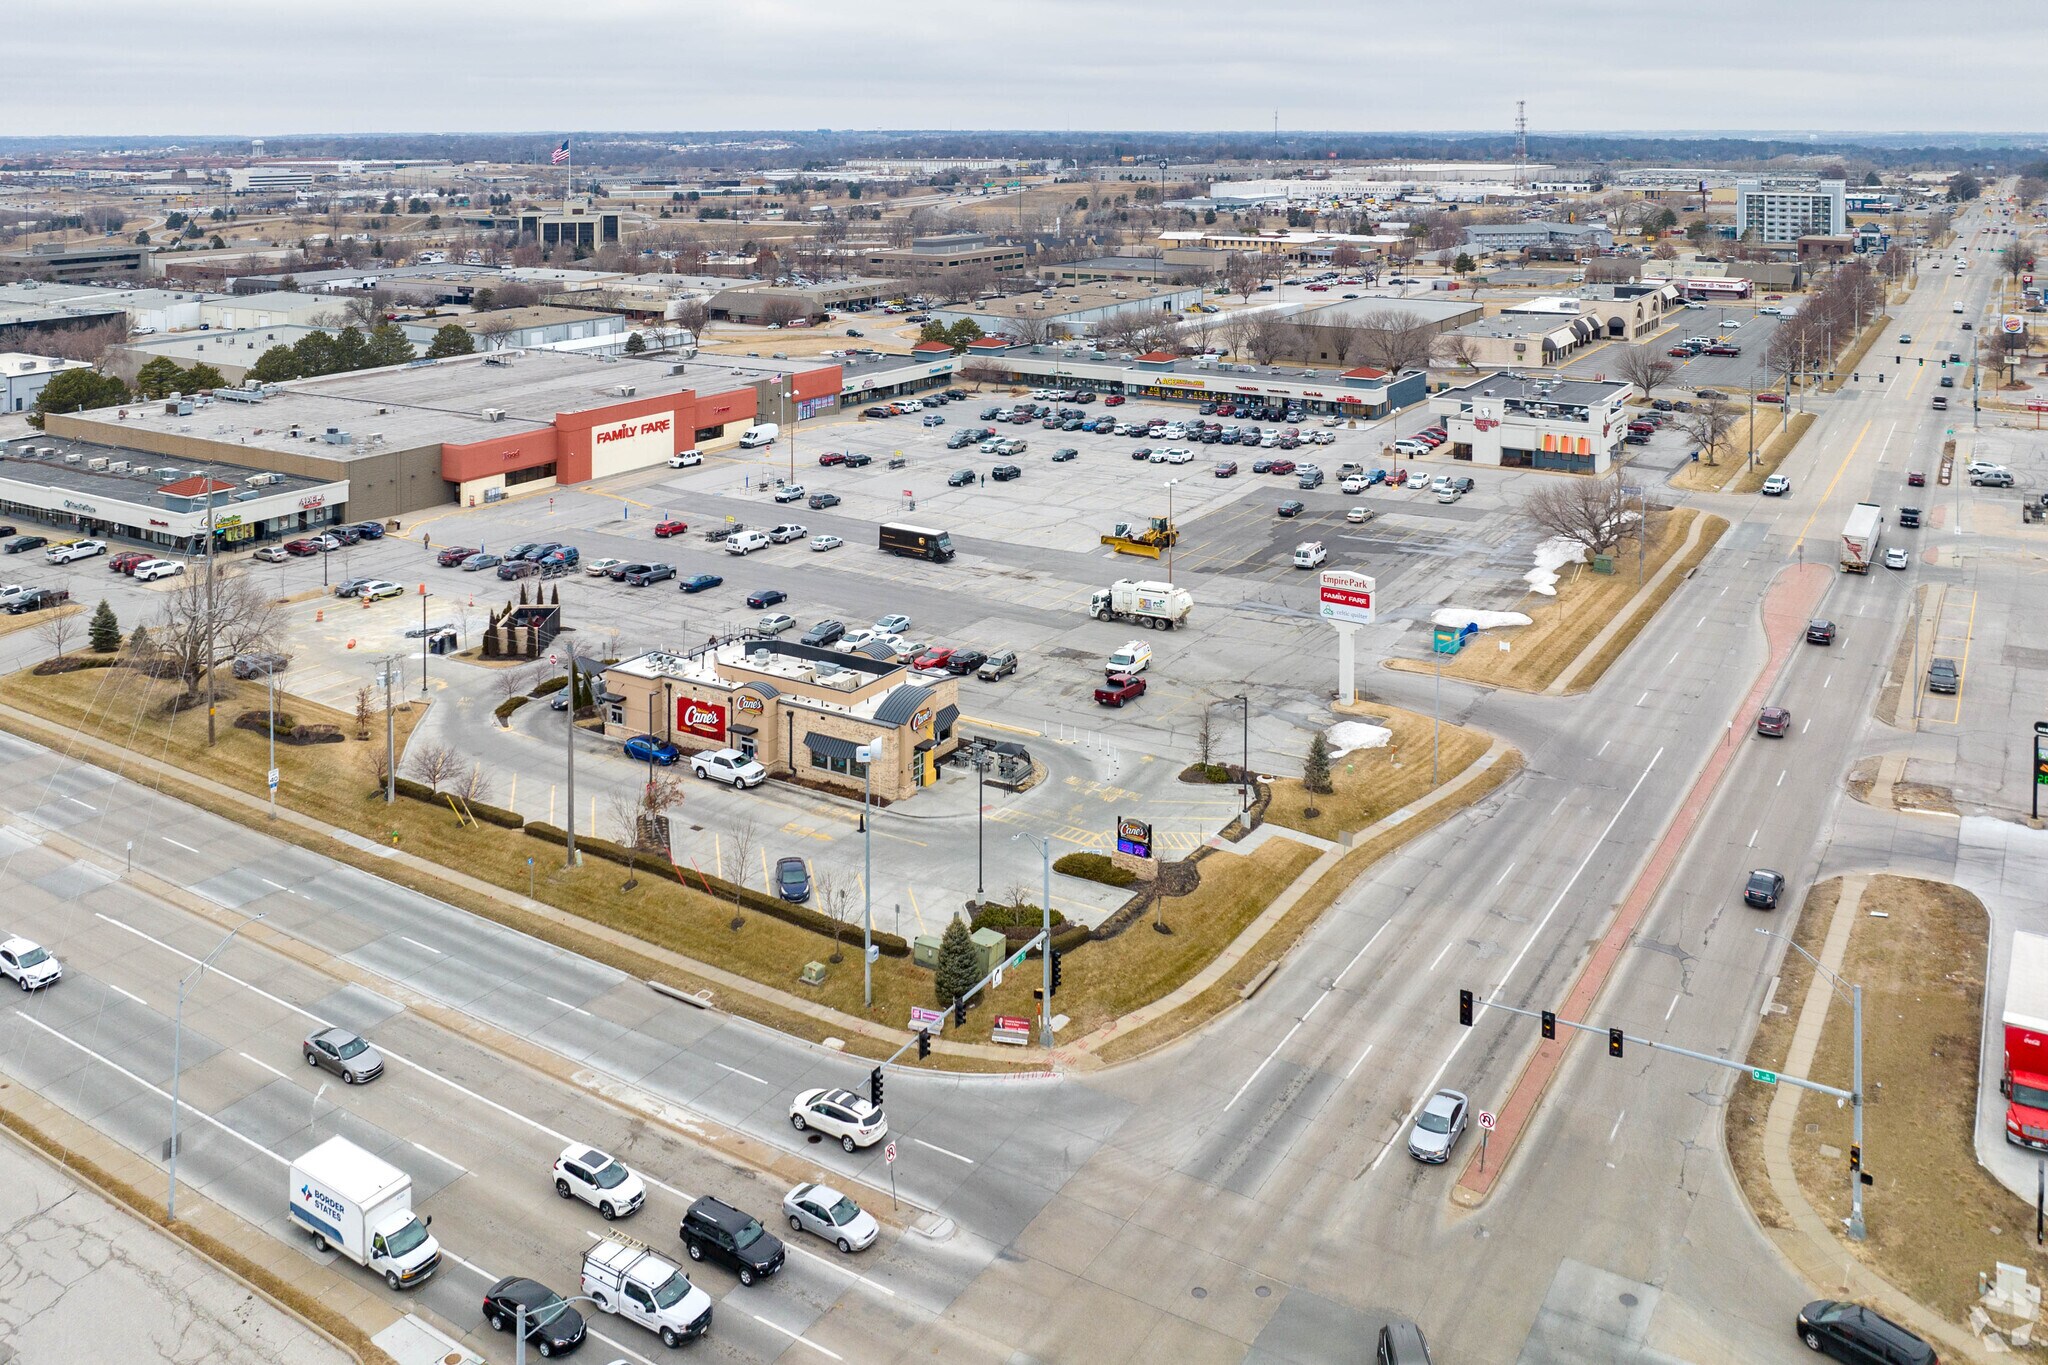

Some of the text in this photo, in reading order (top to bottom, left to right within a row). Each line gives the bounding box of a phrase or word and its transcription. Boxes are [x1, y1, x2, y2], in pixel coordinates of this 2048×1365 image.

[640, 419, 671, 435] FARE
[1323, 574, 1368, 589] Empire Park
[1348, 596, 1367, 605] FARE
[738, 695, 763, 710] Cane's
[684, 705, 719, 726] Cane's
[269, 775, 279, 783] 40
[1120, 822, 1145, 836] Cane's
[314, 1189, 345, 1214] BORDER
[314, 1200, 342, 1222] STATES
